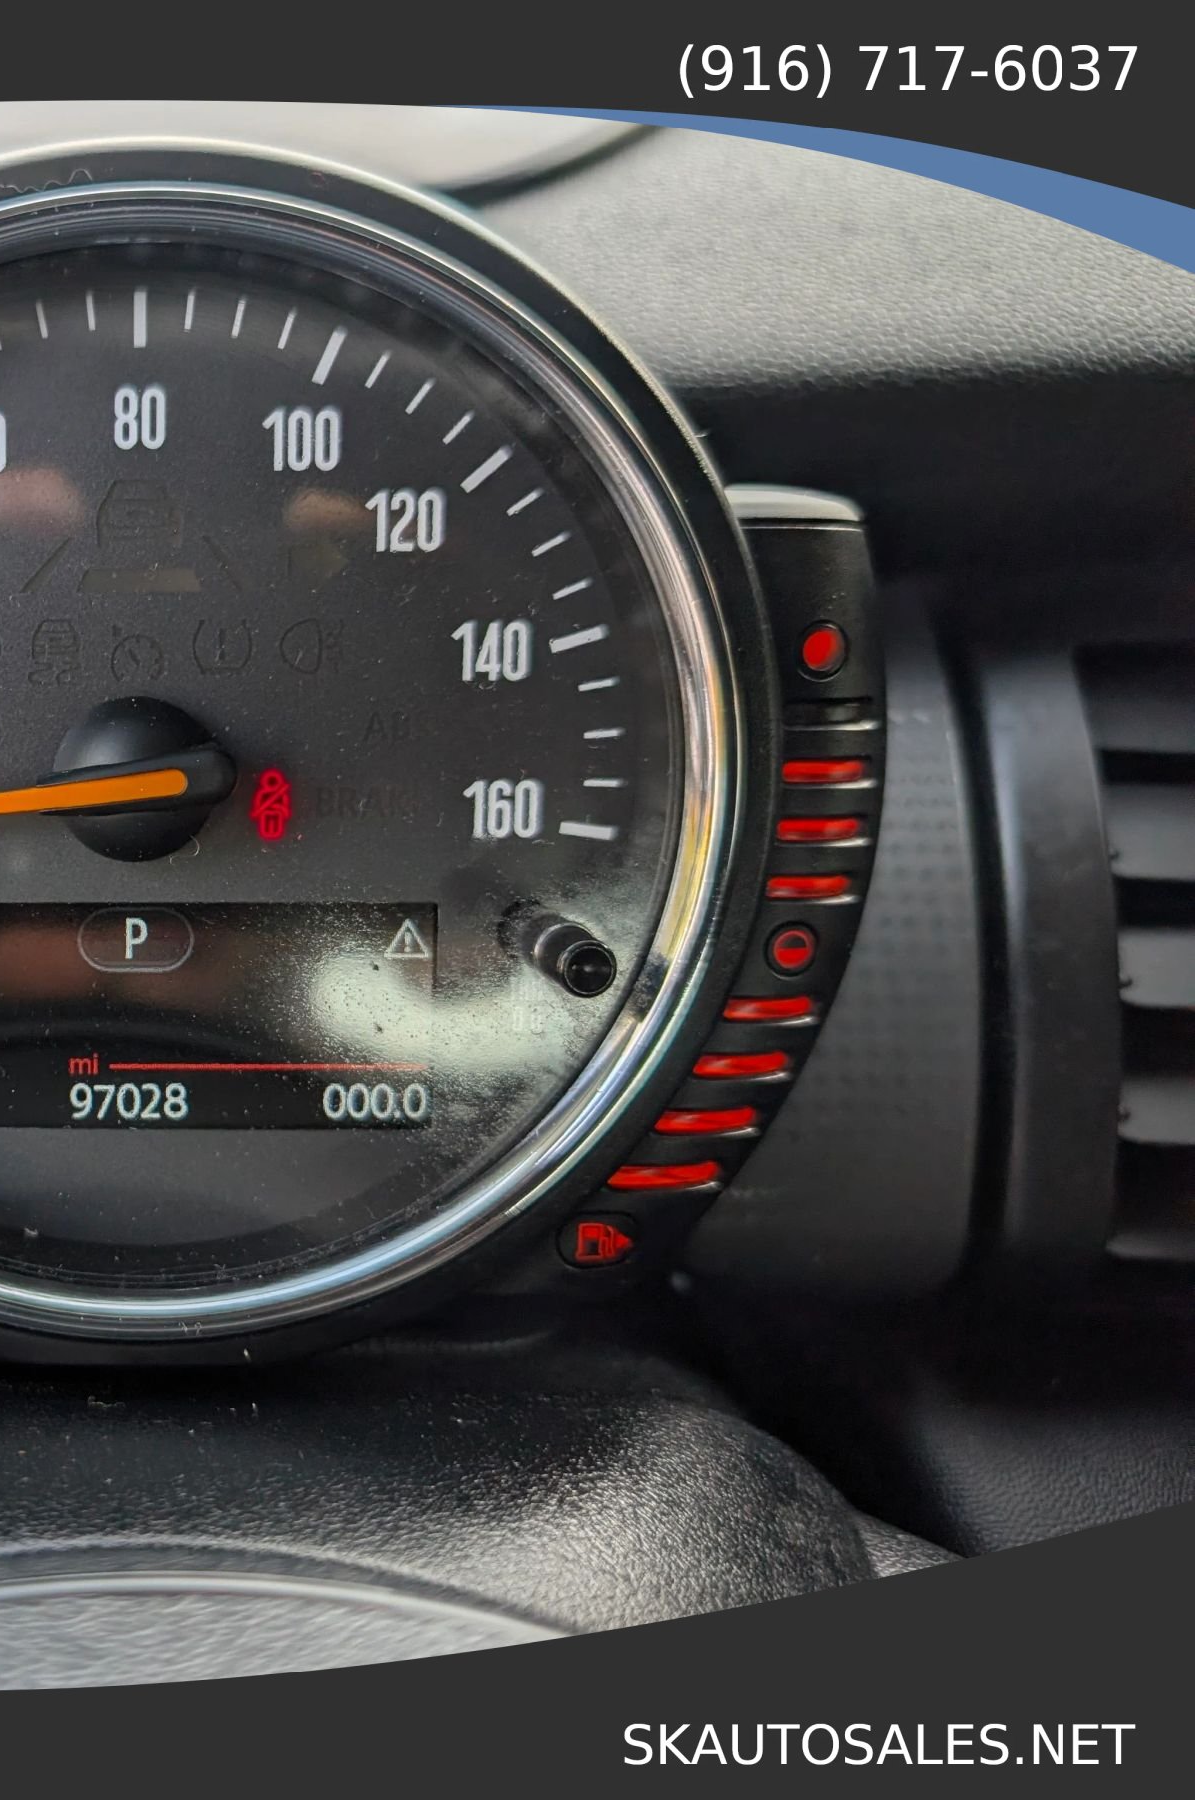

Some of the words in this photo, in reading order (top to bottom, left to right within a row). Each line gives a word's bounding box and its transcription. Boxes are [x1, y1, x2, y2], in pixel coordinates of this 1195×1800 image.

[113, 383, 166, 450] 80
[262, 407, 342, 472] 100
[365, 487, 446, 553] 120
[450, 619, 532, 682] 140
[463, 778, 544, 839] 160
[124, 917, 149, 960] P
[68, 1053, 99, 1075] mi
[68, 1082, 189, 1120] 97028
[321, 1082, 428, 1121] 000.0
